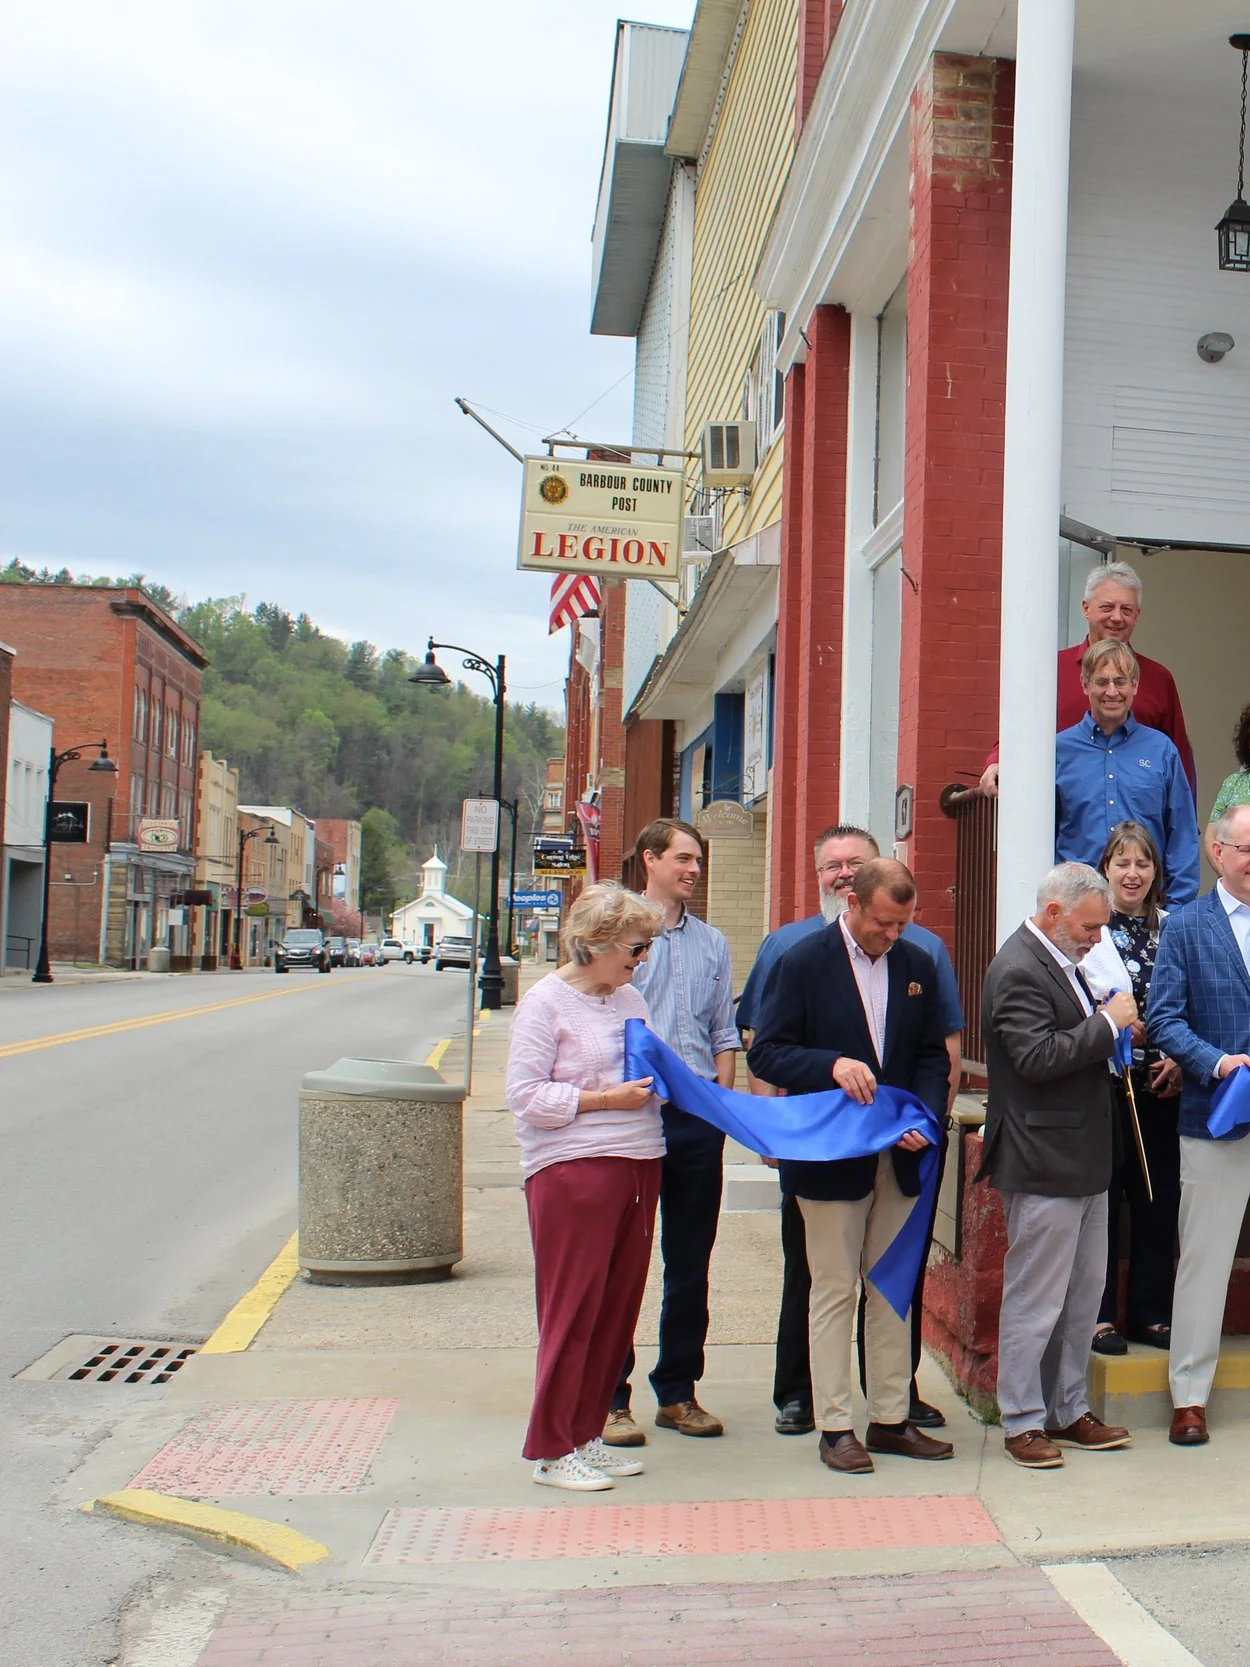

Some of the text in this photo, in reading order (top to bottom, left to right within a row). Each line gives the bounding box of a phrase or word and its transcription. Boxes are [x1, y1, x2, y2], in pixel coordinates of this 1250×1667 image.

[580, 473, 673, 494] BARBOUR COUNTY
[612, 496, 638, 512] POST
[567, 522, 639, 536] THE AMERICAN
[530, 531, 670, 567] LEGION
[1138, 759, 1152, 768] SC
[475, 805, 488, 814] NO
[702, 809, 749, 825] Welcome
[466, 815, 495, 825] PARKING
